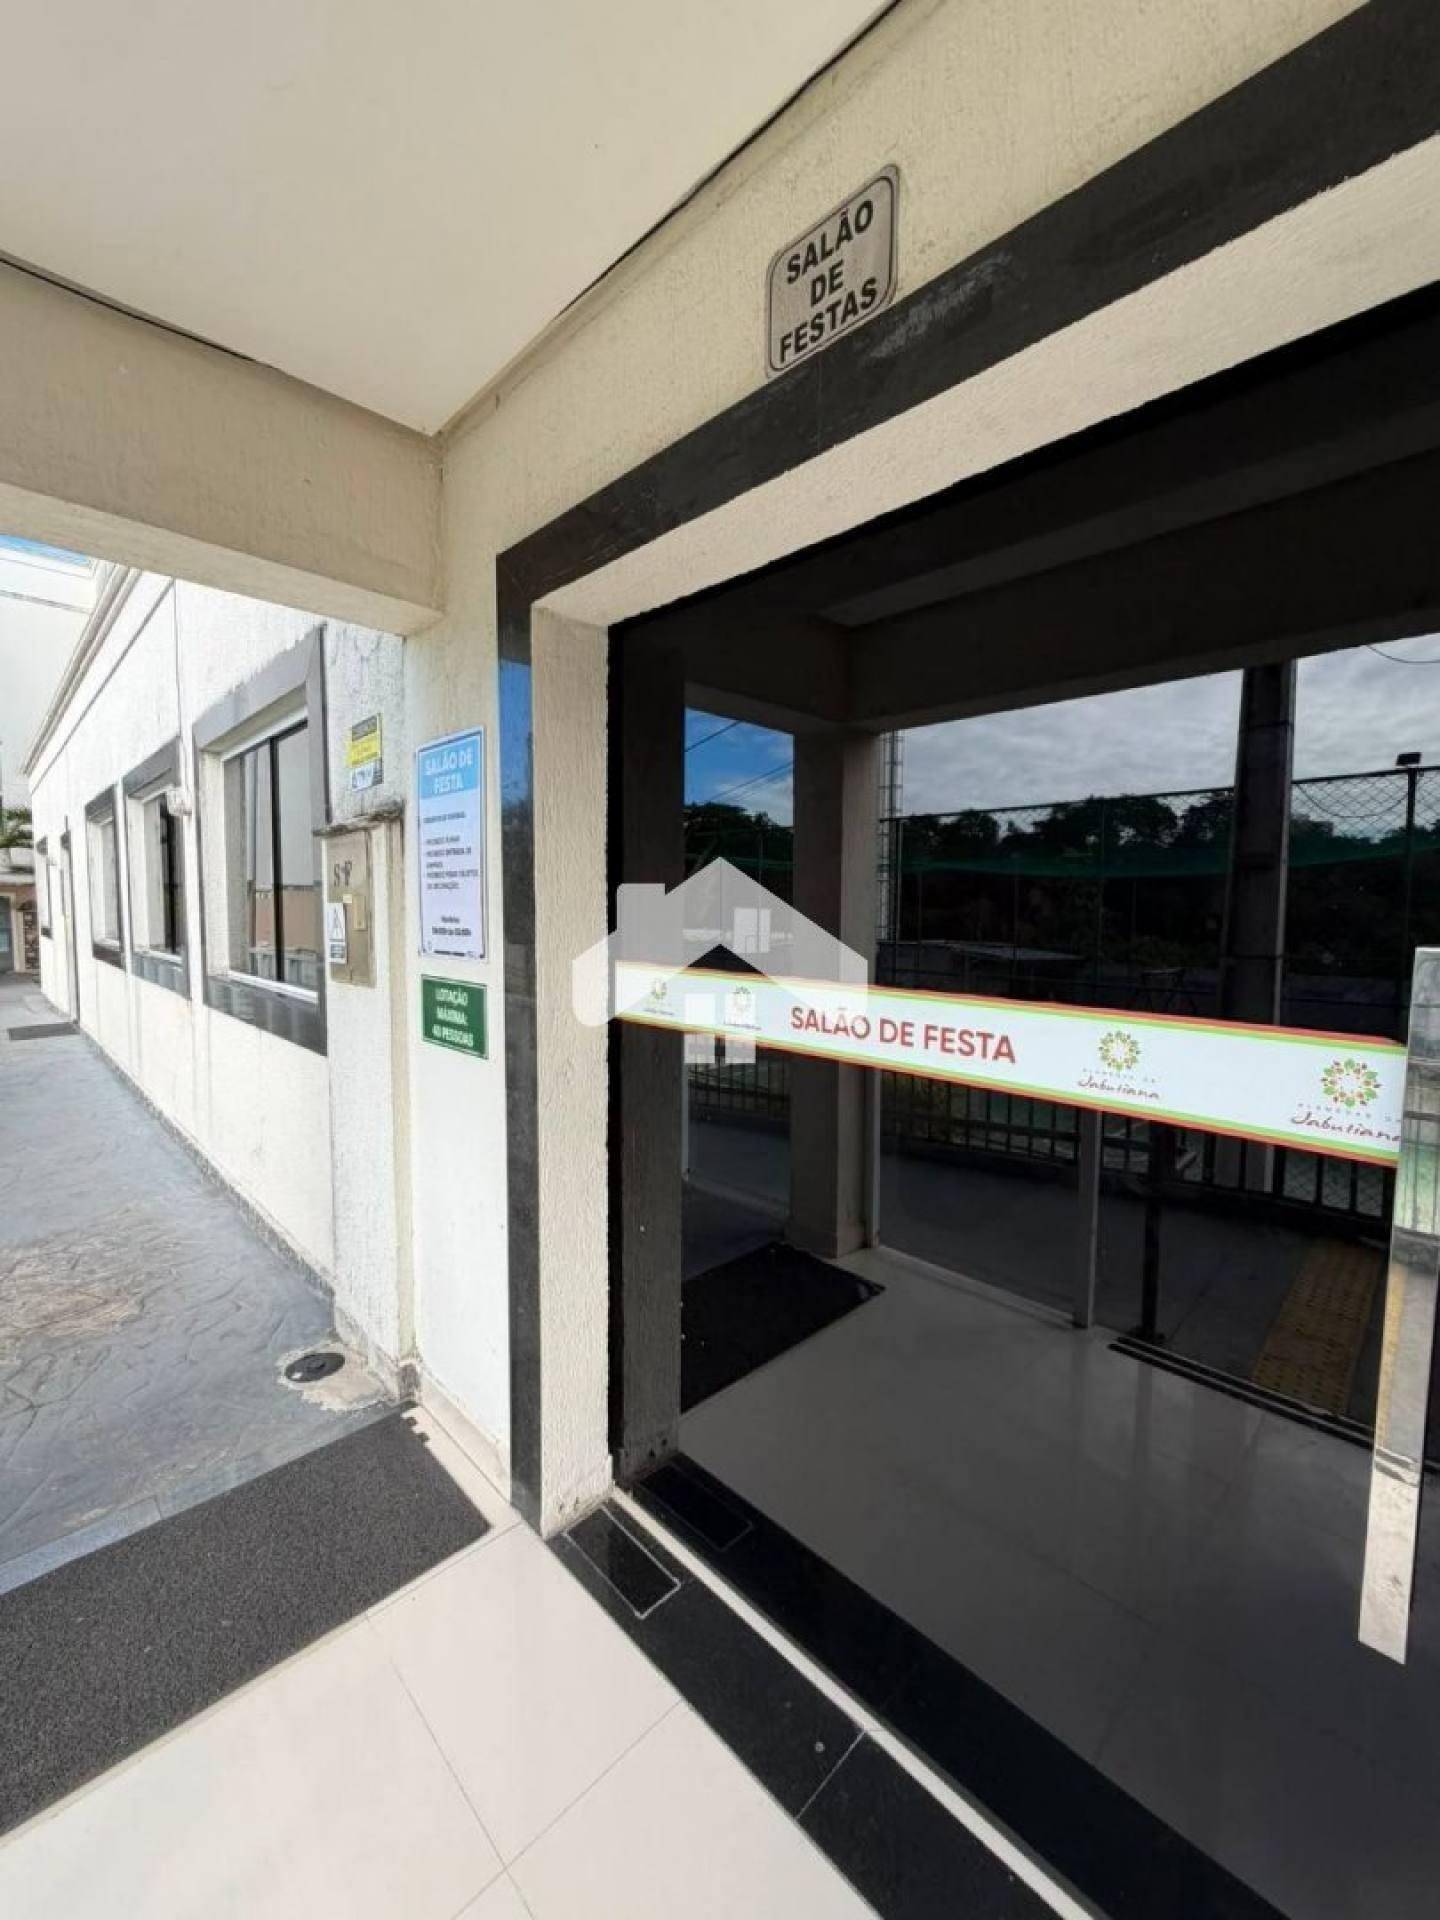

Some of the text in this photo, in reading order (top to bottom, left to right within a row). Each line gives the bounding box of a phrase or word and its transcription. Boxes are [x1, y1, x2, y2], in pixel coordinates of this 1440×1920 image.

[787, 200, 873, 284] SALÃO
[811, 259, 843, 308] DE
[780, 277, 877, 363] FESTAS
[459, 746, 473, 768] DE
[432, 772, 464, 795] FESTA
[791, 1006, 1017, 1064] SALÃO DE FESTA
[1077, 1073, 1160, 1099] Jabutiana
